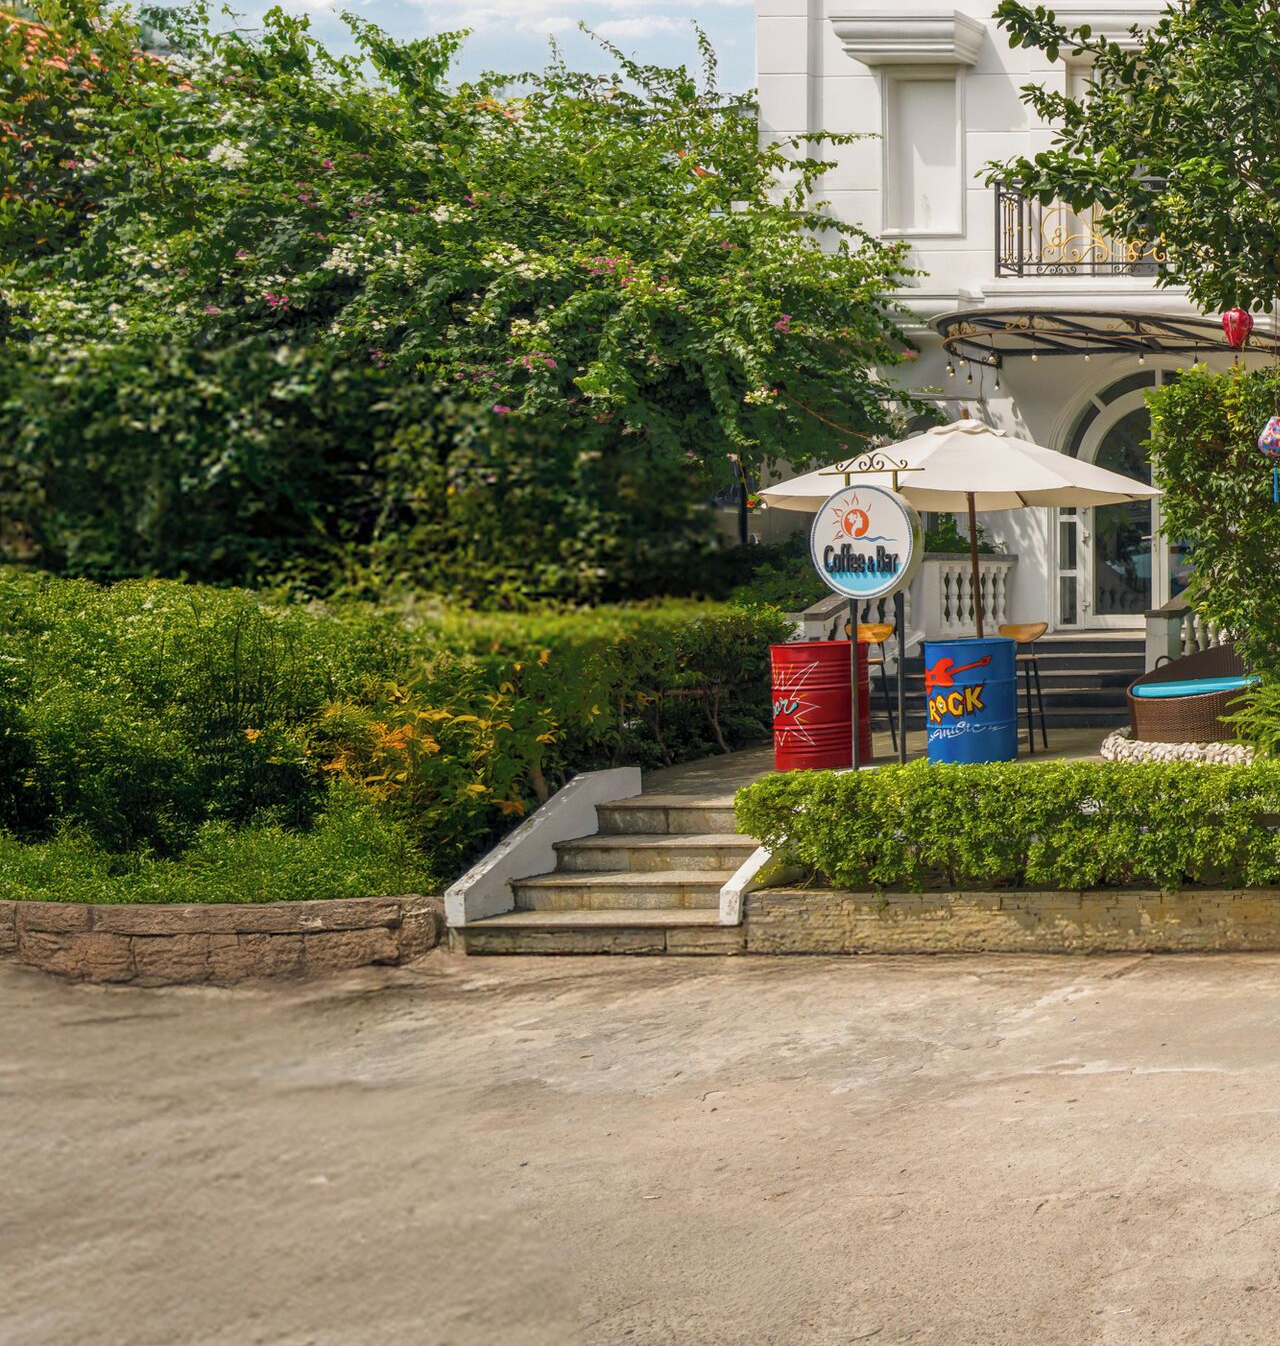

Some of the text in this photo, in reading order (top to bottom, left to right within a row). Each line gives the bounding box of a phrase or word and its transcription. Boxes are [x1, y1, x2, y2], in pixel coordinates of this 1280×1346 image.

[823, 543, 899, 574] Coffee & Bar
[928, 682, 987, 726] ROCK
